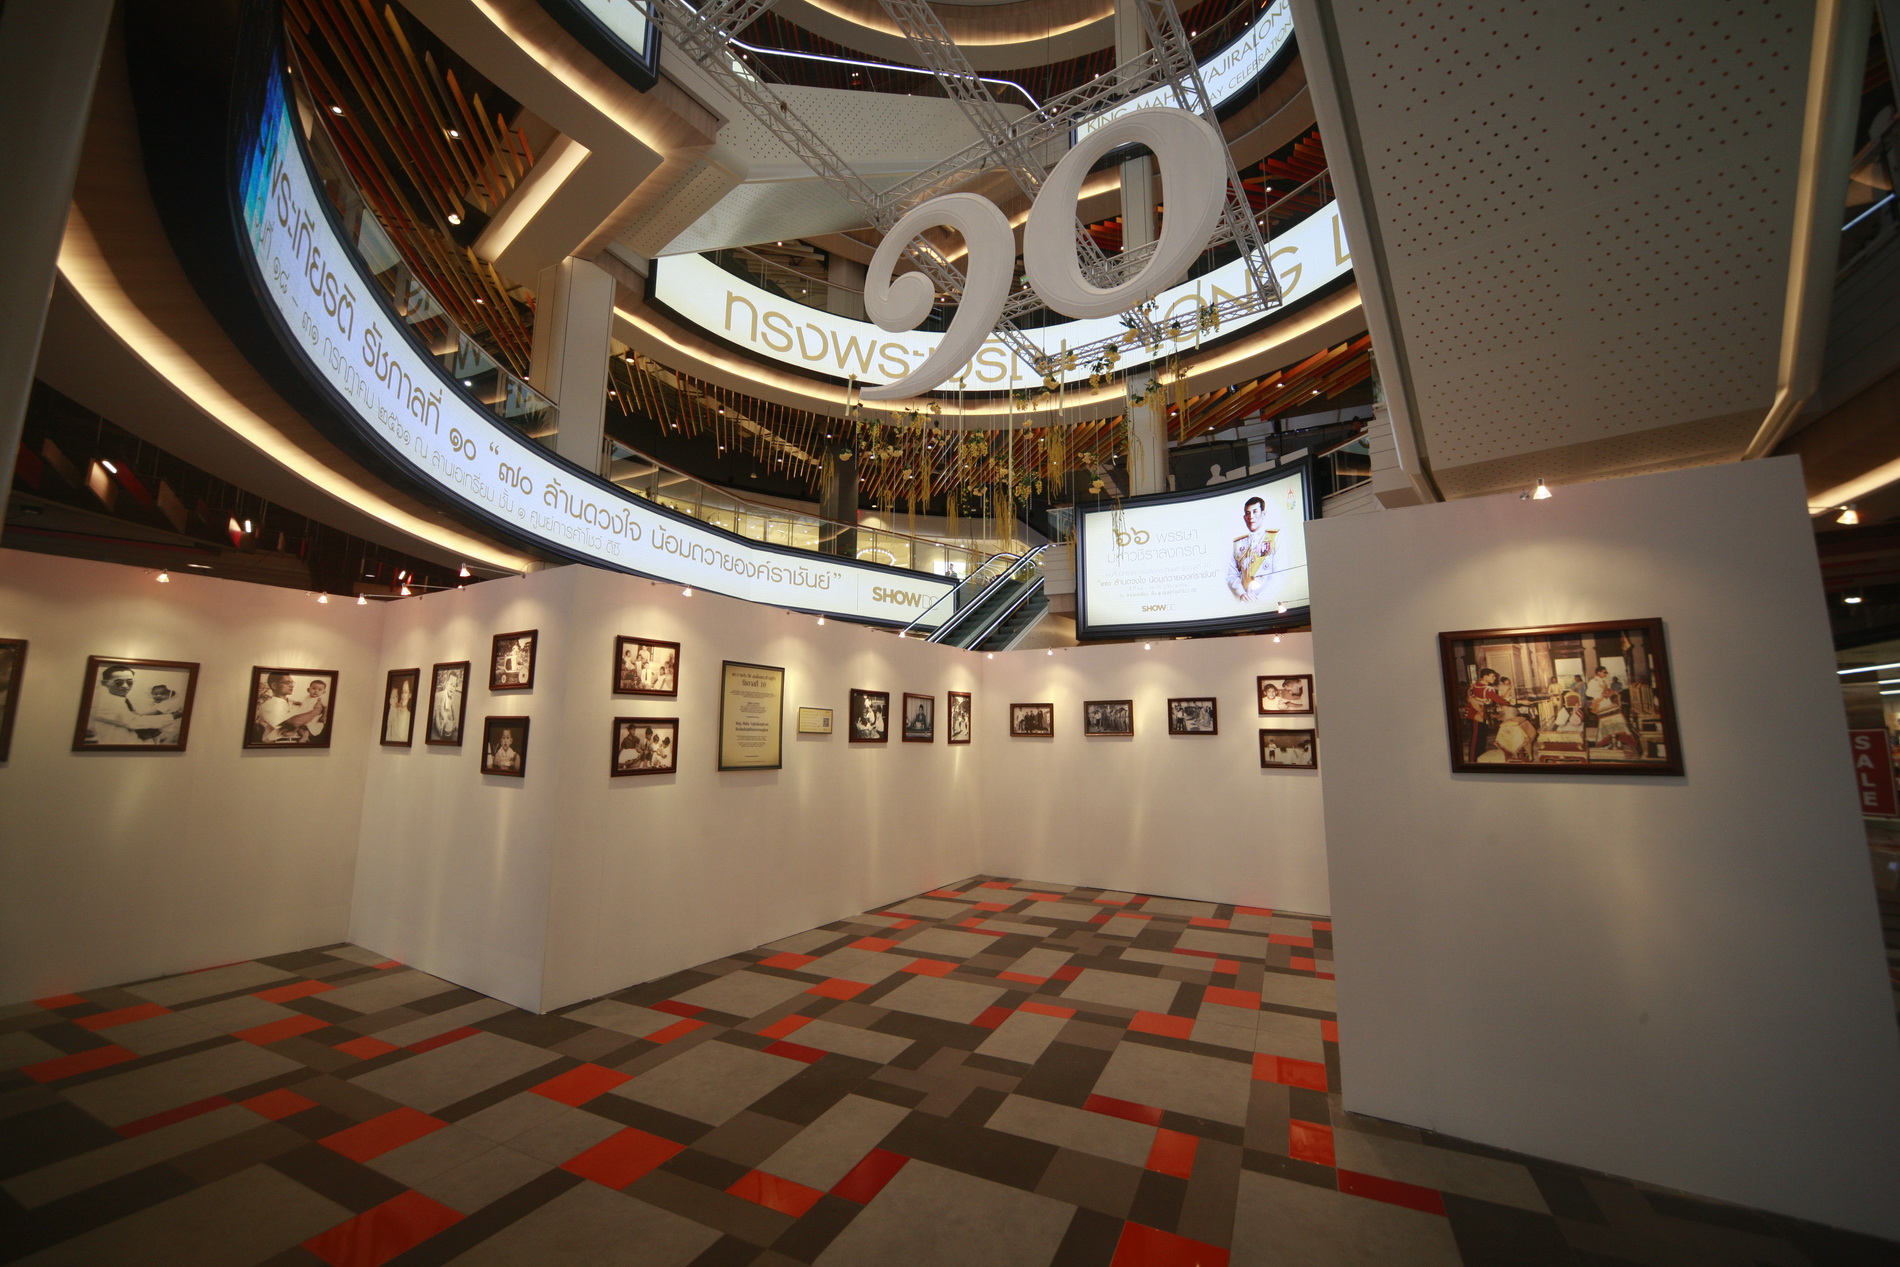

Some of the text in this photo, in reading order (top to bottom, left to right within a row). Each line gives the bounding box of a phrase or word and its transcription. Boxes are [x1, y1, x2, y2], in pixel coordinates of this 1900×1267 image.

[362, 321, 443, 435] รัชกาลที่
[543, 478, 642, 541] ล้านดวงใจ
[1854, 735, 1878, 807] SALE
